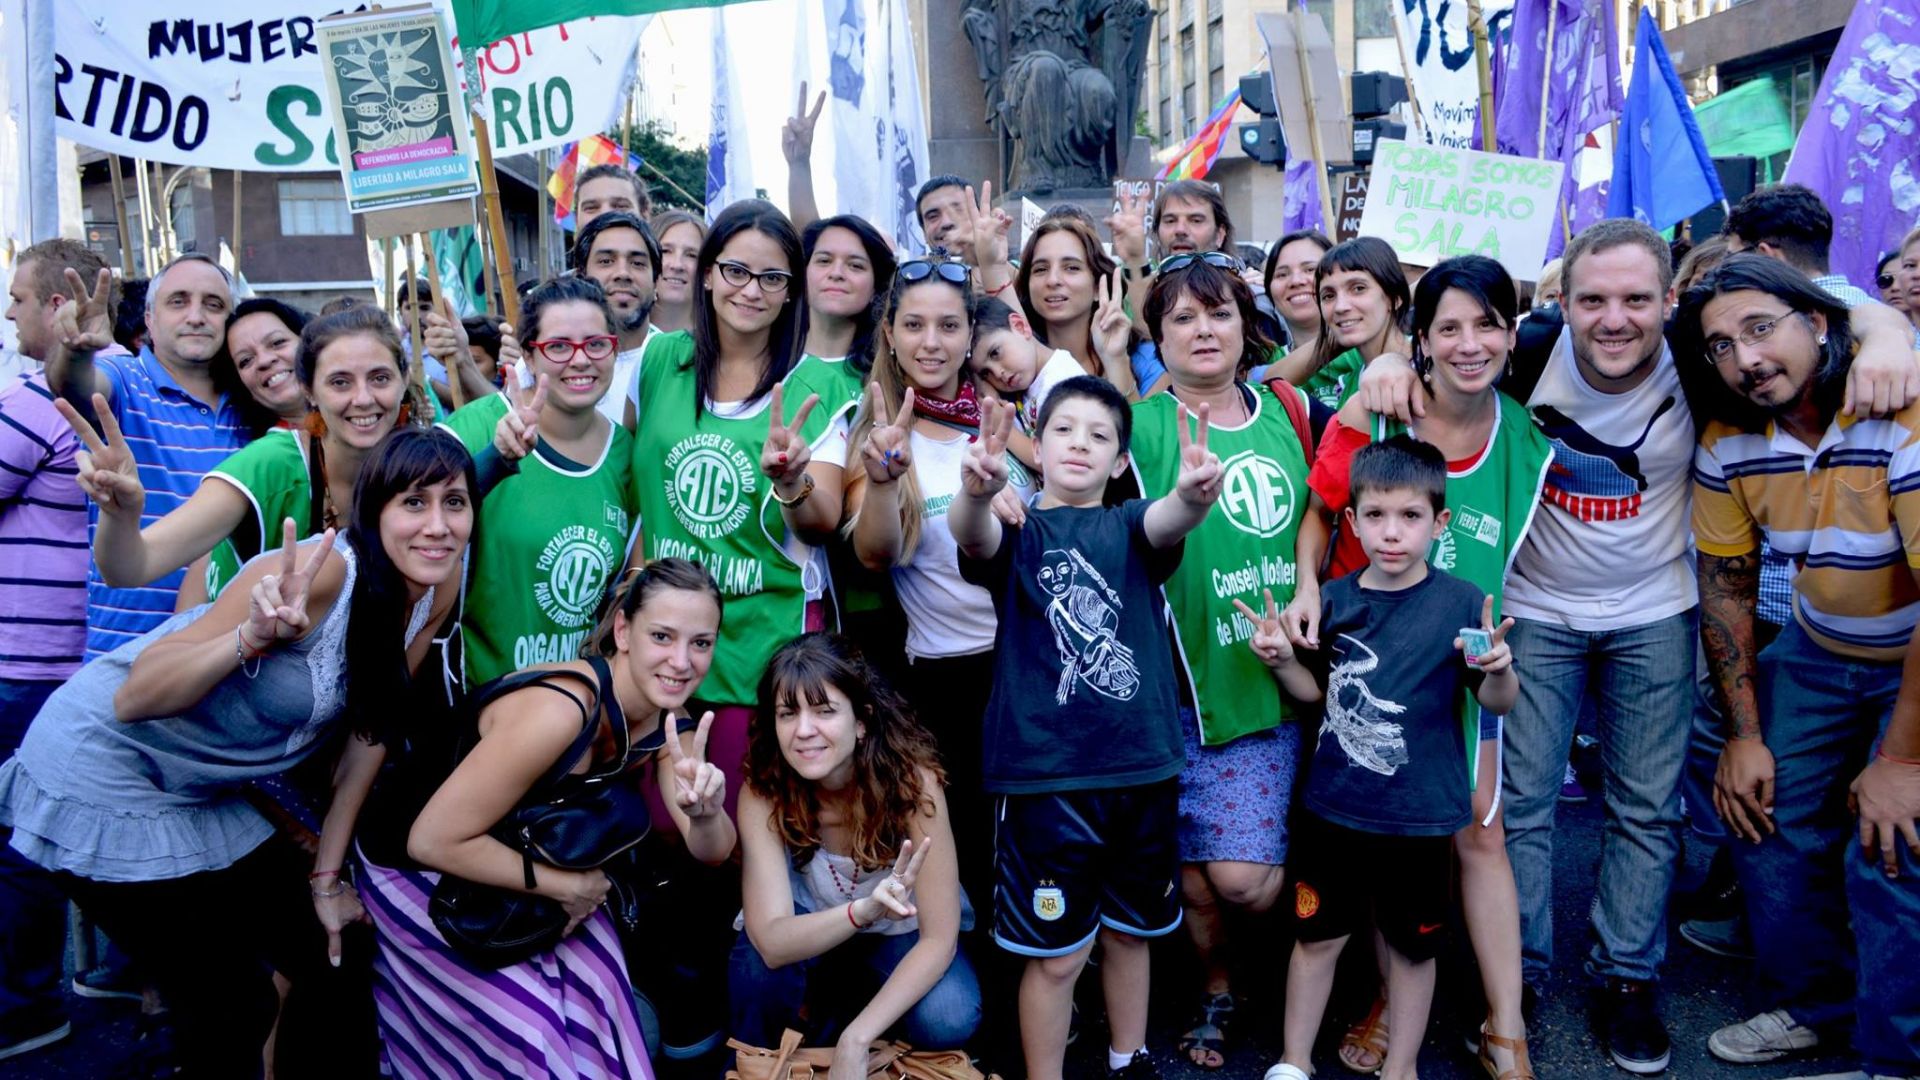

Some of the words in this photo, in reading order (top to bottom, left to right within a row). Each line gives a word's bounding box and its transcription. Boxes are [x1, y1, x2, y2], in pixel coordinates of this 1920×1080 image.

[149, 4, 368, 64] MUJER
[55, 53, 209, 151] RTIDO
[353, 172, 394, 189] LIBERTAD
[395, 172, 403, 182] A
[403, 166, 441, 182] MILAGRO
[442, 163, 465, 176] SALA
[361, 154, 401, 166] DEFENDEMOS
[401, 152, 410, 161] LA
[410, 146, 448, 160] DEMOCRACIA
[1381, 142, 1458, 178] TODAS
[1472, 157, 1554, 190] SOMOS
[1386, 174, 1535, 220] MILAGRO
[1393, 212, 1501, 261] SALA
[664, 433, 721, 470] FORTALECER
[720, 438, 735, 455] EL
[731, 449, 756, 493] ESTADO
[680, 456, 732, 515] ATE
[664, 480, 677, 508] PARA
[674, 506, 707, 539] LIBERAR
[709, 523, 723, 539] LA
[921, 493, 954, 511] NIDOS
[1223, 456, 1289, 531] ATE
[1458, 512, 1480, 531] VERDE
[536, 525, 584, 571] FORTALECER
[587, 528, 598, 544] EL
[1439, 525, 1457, 569] STADO
[558, 549, 601, 605] ATE
[1212, 559, 1260, 598] Consejo
[534, 582, 551, 611] PARA
[550, 605, 586, 628] LIBERAR
[1216, 616, 1232, 647] de
